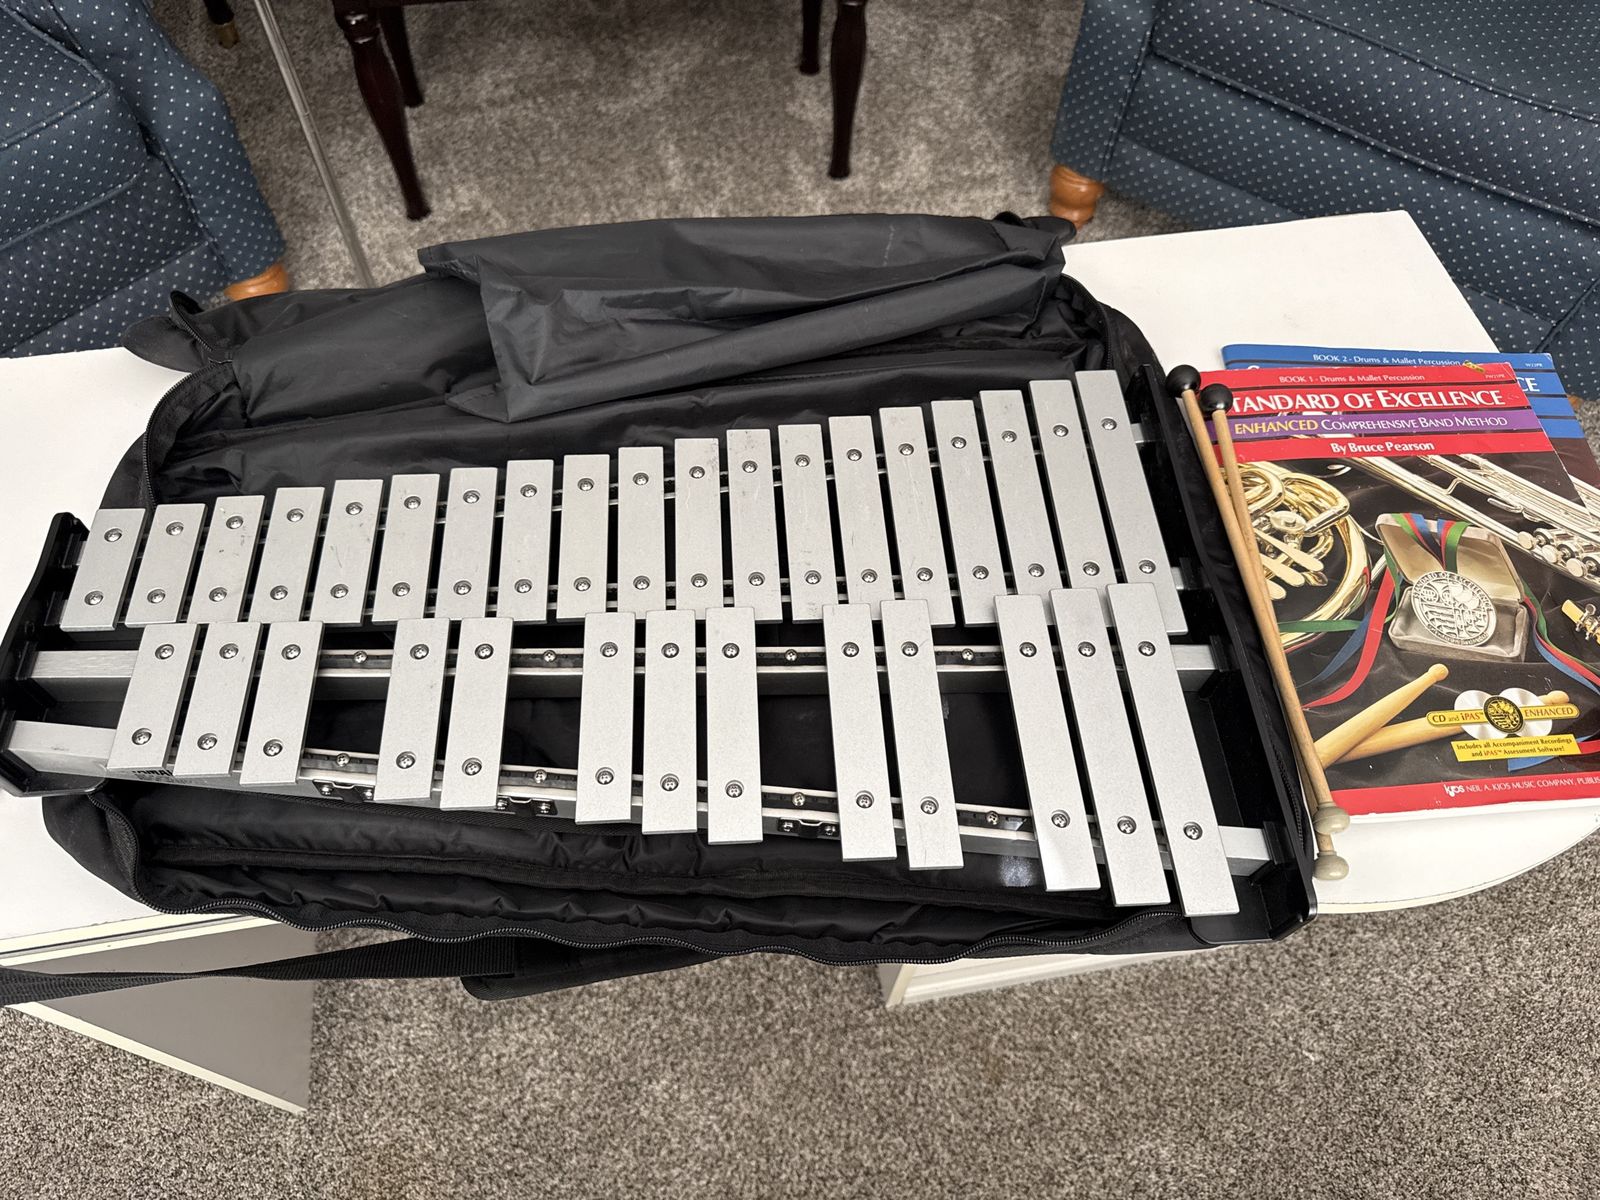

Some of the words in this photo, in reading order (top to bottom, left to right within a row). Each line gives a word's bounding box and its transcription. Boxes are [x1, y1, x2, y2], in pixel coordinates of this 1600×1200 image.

[1313, 354, 1340, 362] BOOK
[1418, 358, 1461, 366] Percussion
[1357, 374, 1381, 382] Mallet
[1231, 393, 1340, 413] TANDARD
[1344, 392, 1375, 409] OF
[1376, 390, 1506, 408] EXCELLENCE
[1235, 420, 1318, 435] ENHANCED
[1321, 418, 1418, 431] COMPREHENSIVE
[1418, 417, 1454, 429] BAND
[1454, 416, 1508, 428] METHOD
[1331, 443, 1346, 455] By
[1349, 443, 1384, 453] Bruce
[1386, 442, 1435, 451] Pearson
[1432, 715, 1446, 723] CD
[1524, 707, 1574, 717] ENHANCED
[1492, 740, 1539, 748] Accompaniment
[1492, 783, 1511, 791] KJOS
[1511, 781, 1536, 789] MUSIC
